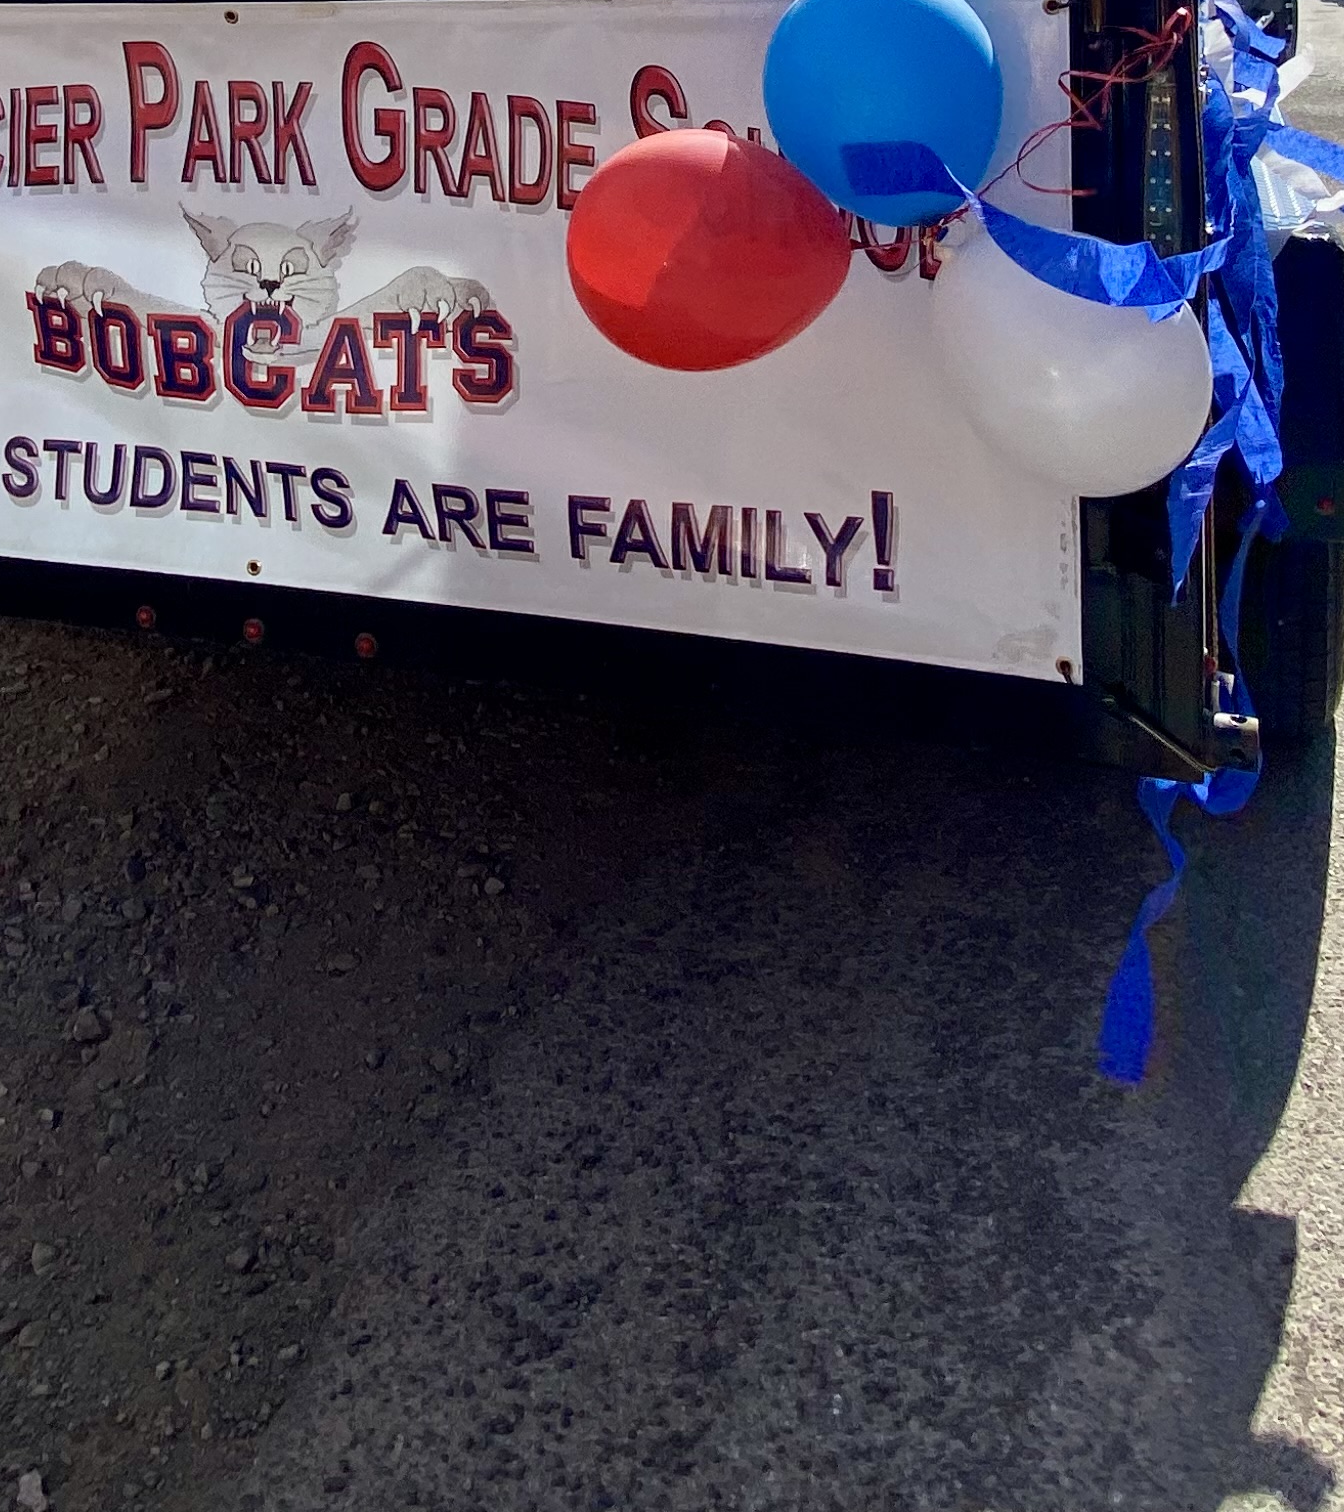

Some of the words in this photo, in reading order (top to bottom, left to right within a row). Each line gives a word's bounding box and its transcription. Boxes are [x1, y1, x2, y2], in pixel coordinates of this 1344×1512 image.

[121, 41, 318, 187] PARK
[341, 41, 597, 211] GRADE
[25, 290, 514, 415] BOBCATS
[2, 436, 355, 530] STUDENTS
[381, 478, 536, 555] ARE
[566, 490, 896, 593] FAMILY!
